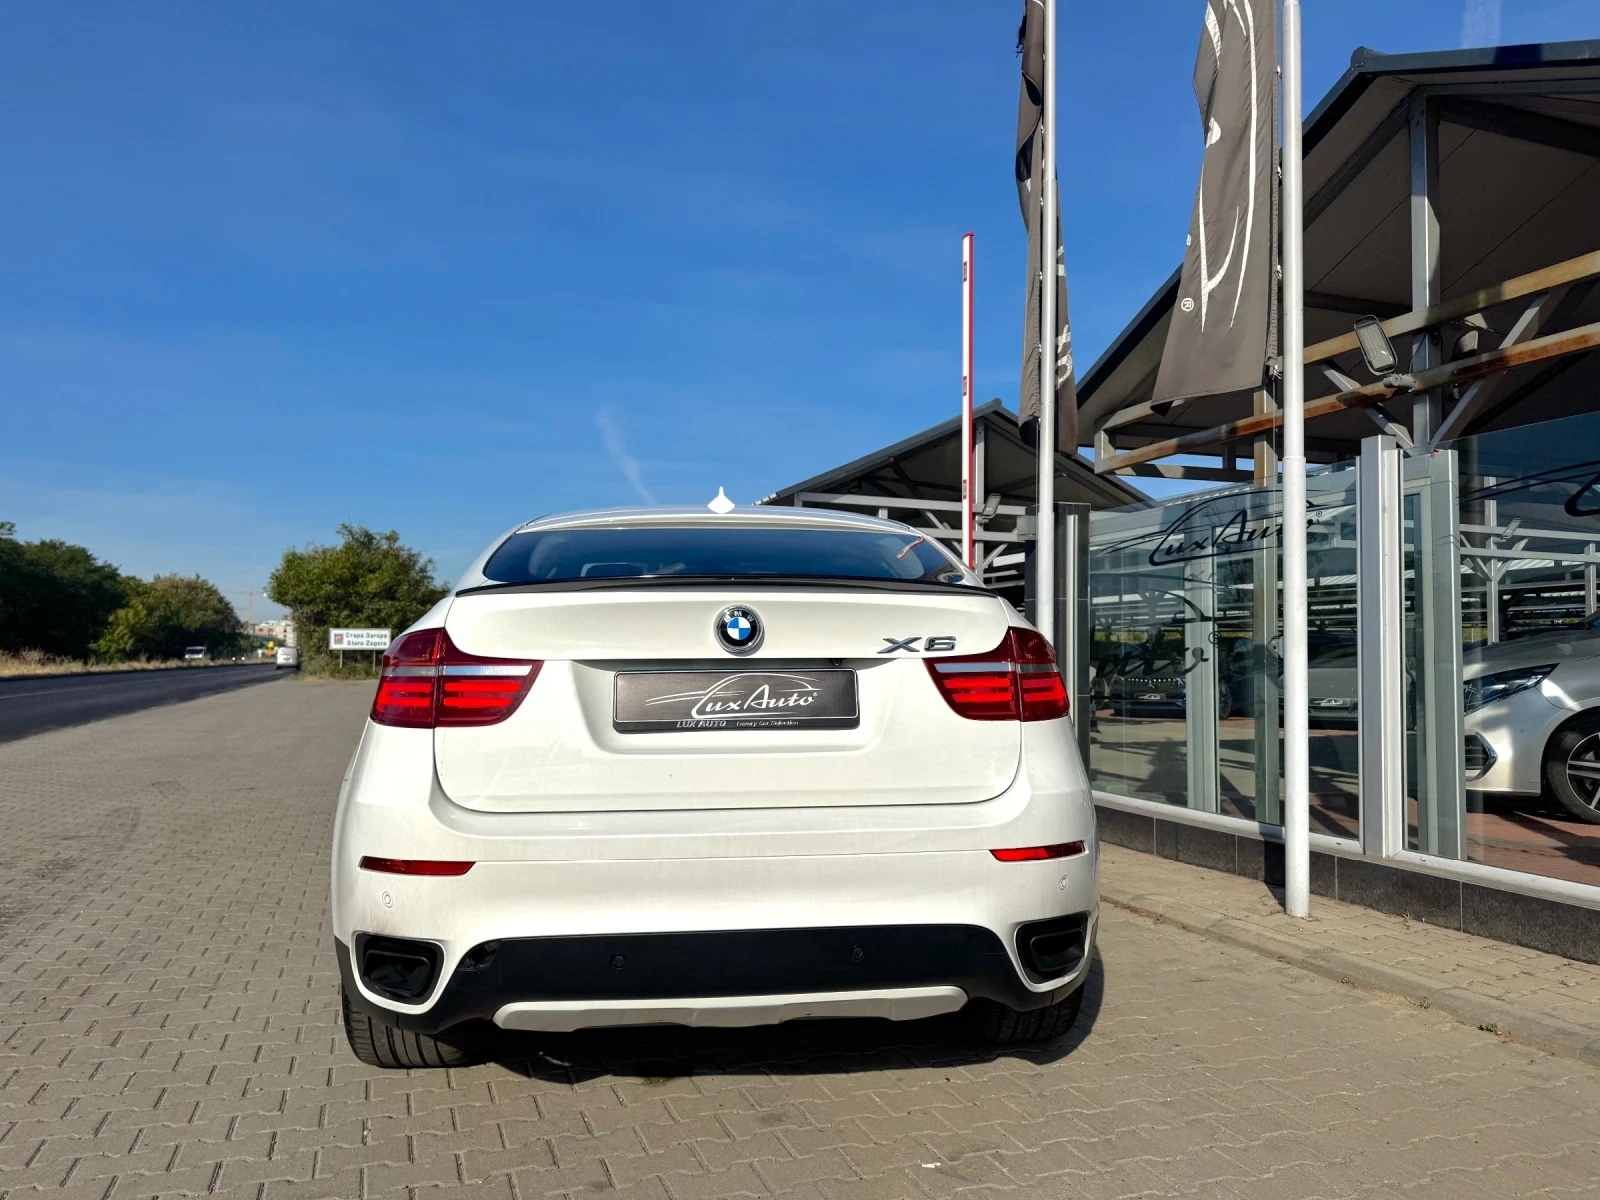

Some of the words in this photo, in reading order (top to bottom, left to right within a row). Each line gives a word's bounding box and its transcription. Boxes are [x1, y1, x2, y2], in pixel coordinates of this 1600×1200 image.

[723, 610, 755, 623] BMW
[345, 632, 364, 640] Стара
[366, 632, 388, 640] Загора
[876, 635, 957, 654] X6
[676, 720, 696, 728] LUX
[697, 720, 727, 728] AUTO
